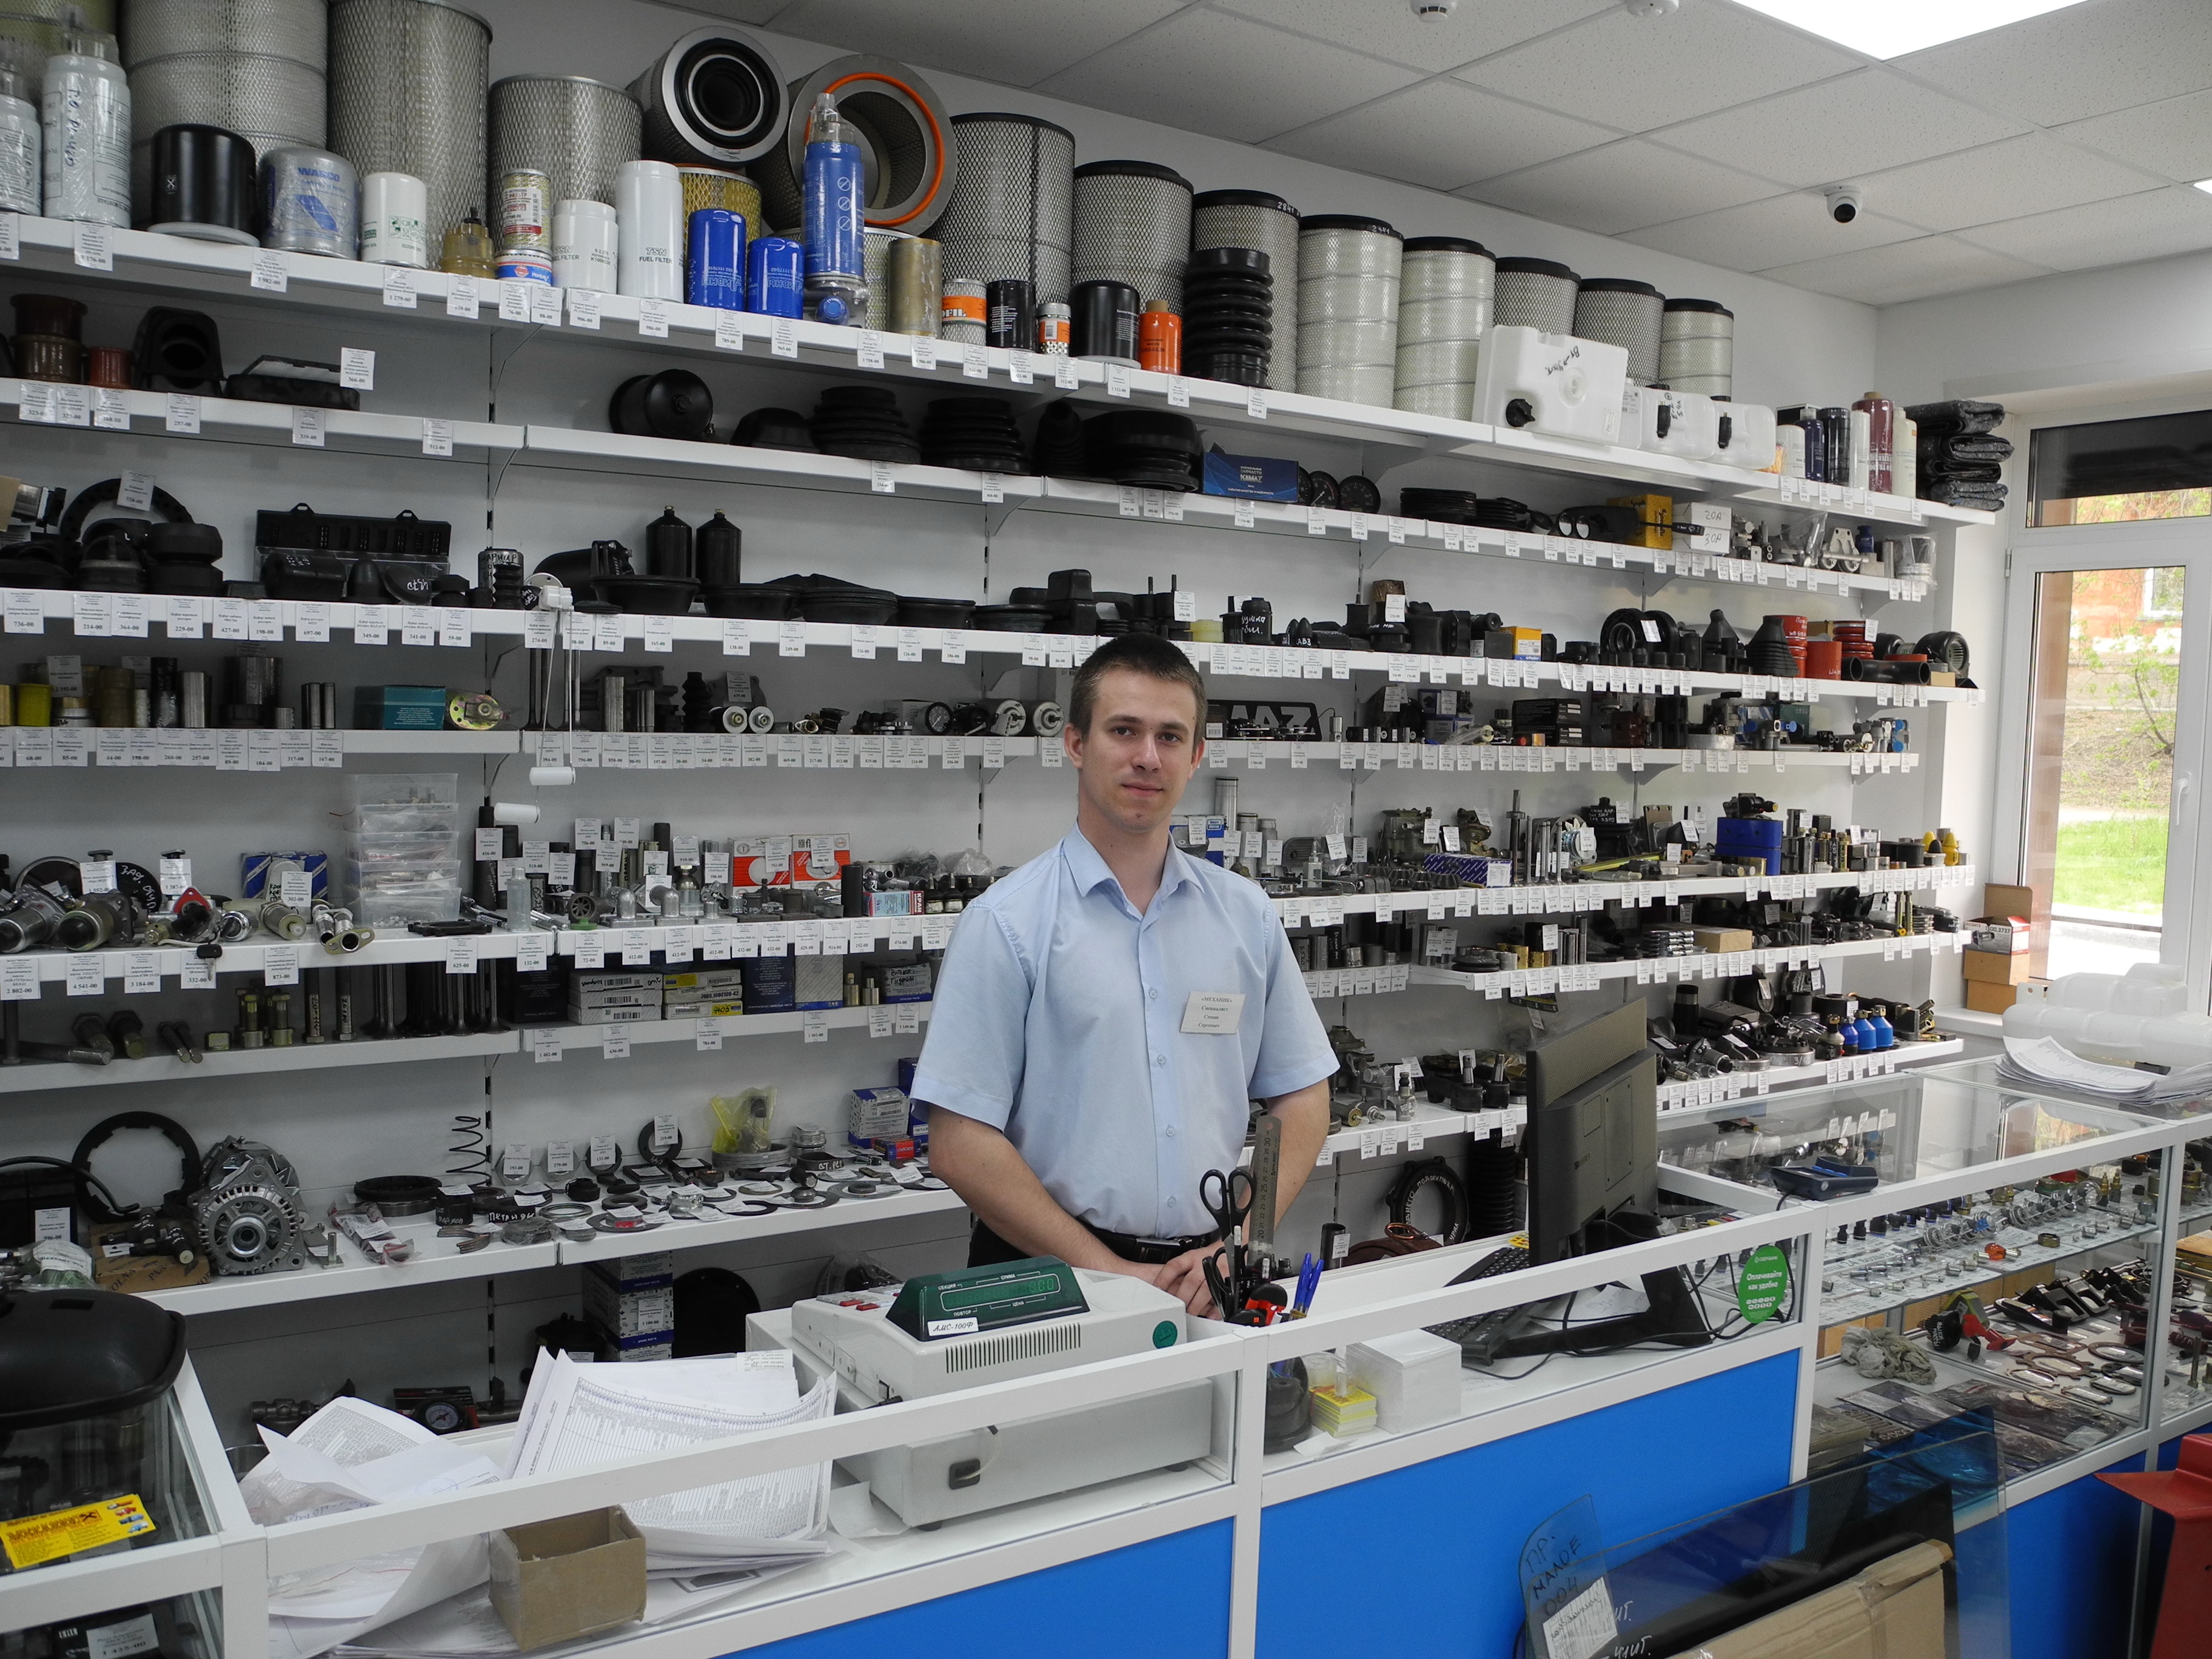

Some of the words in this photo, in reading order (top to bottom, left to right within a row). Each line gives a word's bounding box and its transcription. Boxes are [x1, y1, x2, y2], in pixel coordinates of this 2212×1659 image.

[298, 167, 341, 183] WABCO
[645, 247, 668, 256] TSN
[1746, 1270, 1783, 1281] Оплачивайте
[937, 1283, 957, 1292] СЕКЦИЯ
[1759, 1281, 1778, 1291] удобно
[933, 1319, 974, 1334] АМС-100Ф
